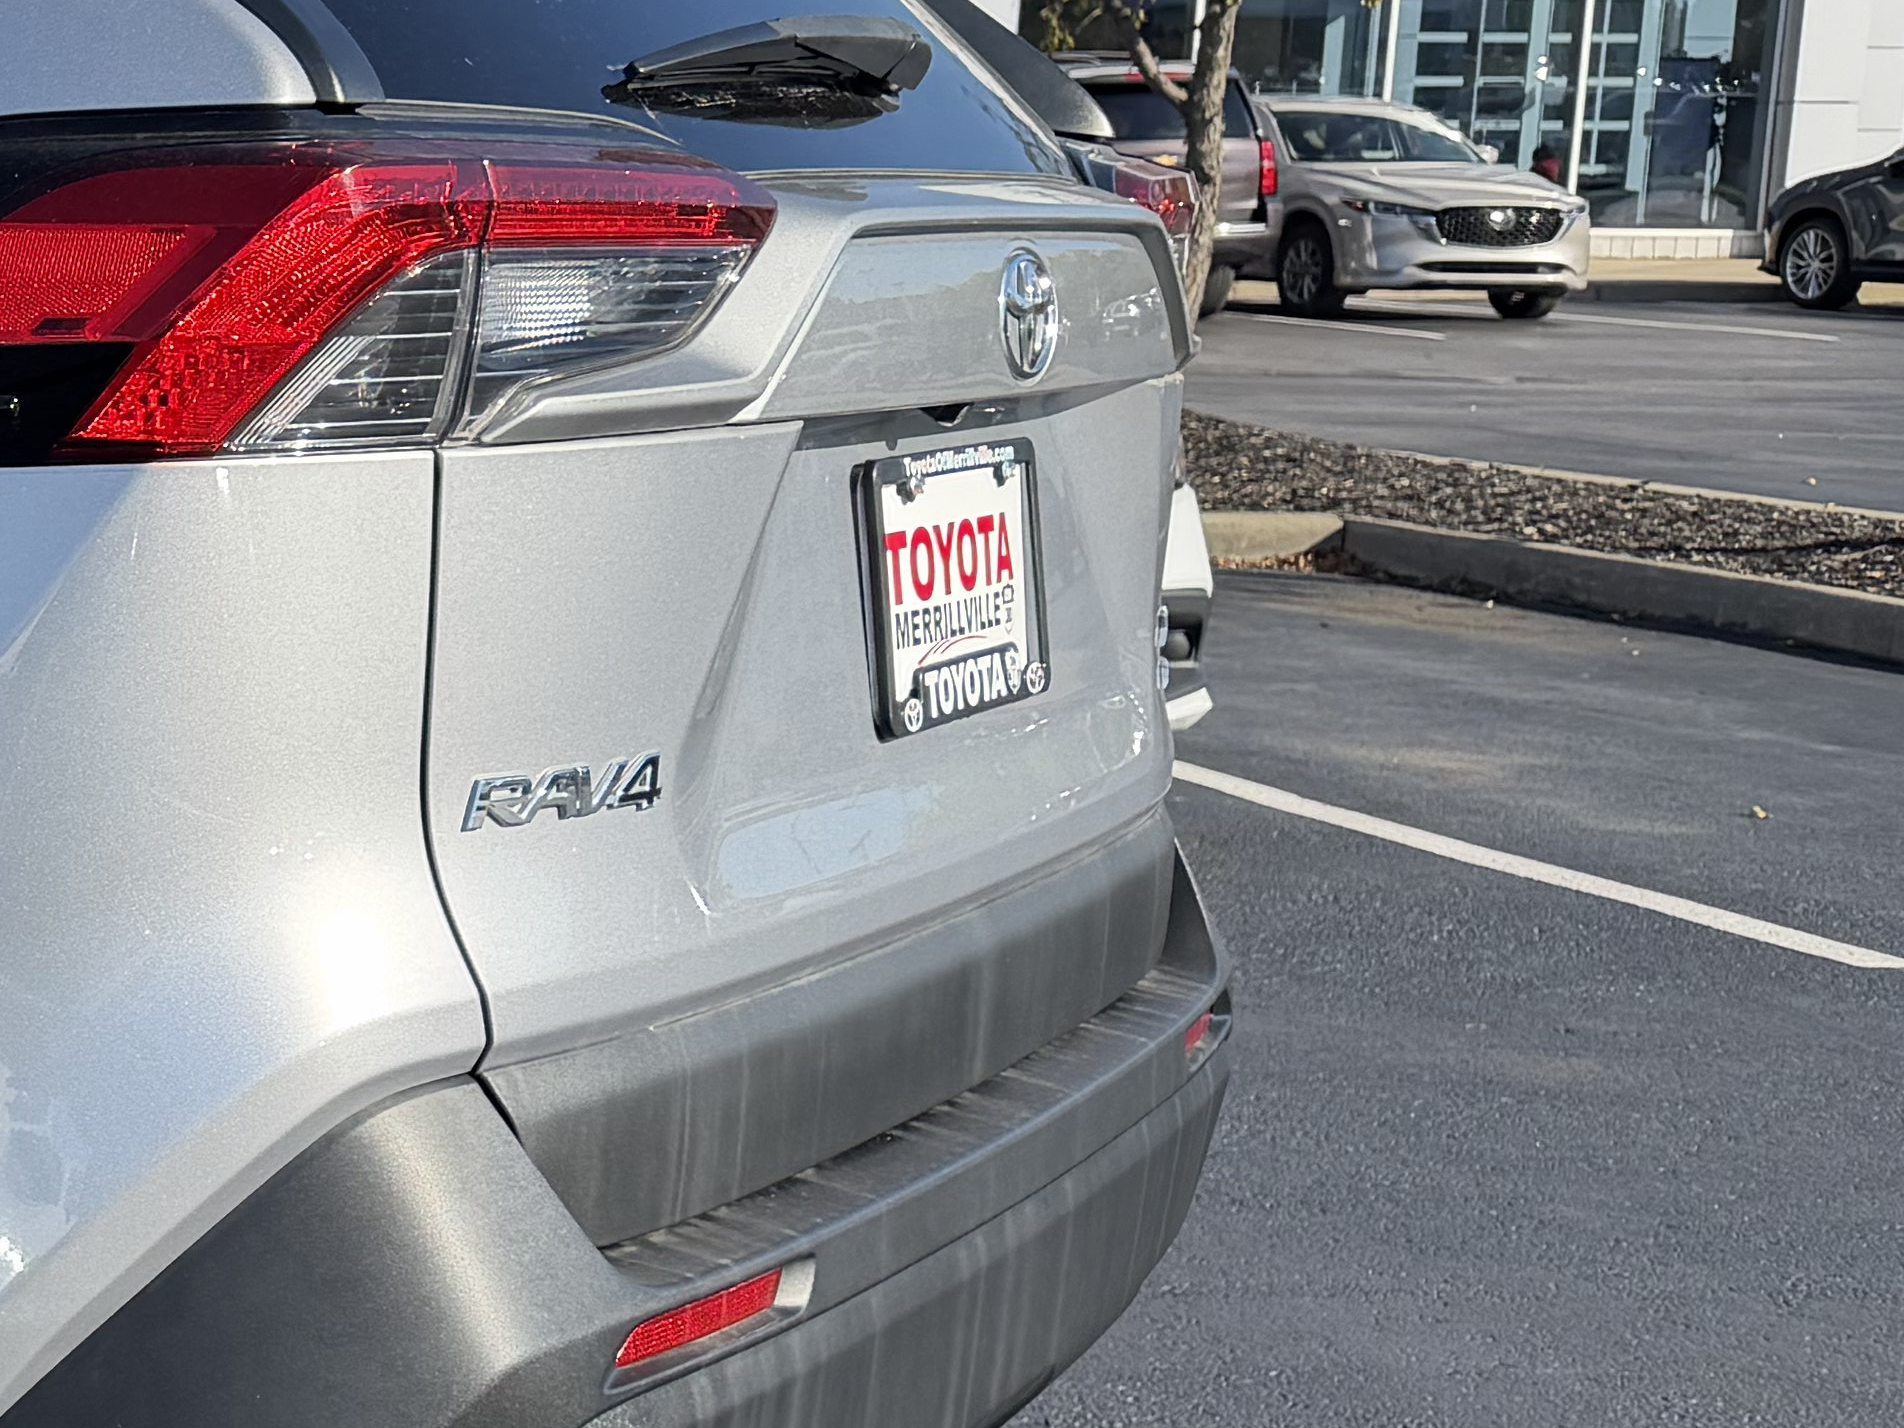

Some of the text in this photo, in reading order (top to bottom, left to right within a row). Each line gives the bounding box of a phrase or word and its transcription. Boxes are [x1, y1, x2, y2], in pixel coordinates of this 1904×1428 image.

[884, 512, 1014, 605] TOYOTA
[895, 591, 1002, 650] MERRILLVILLE
[925, 651, 1008, 719] TOYOTA
[461, 749, 662, 833] RAV4
